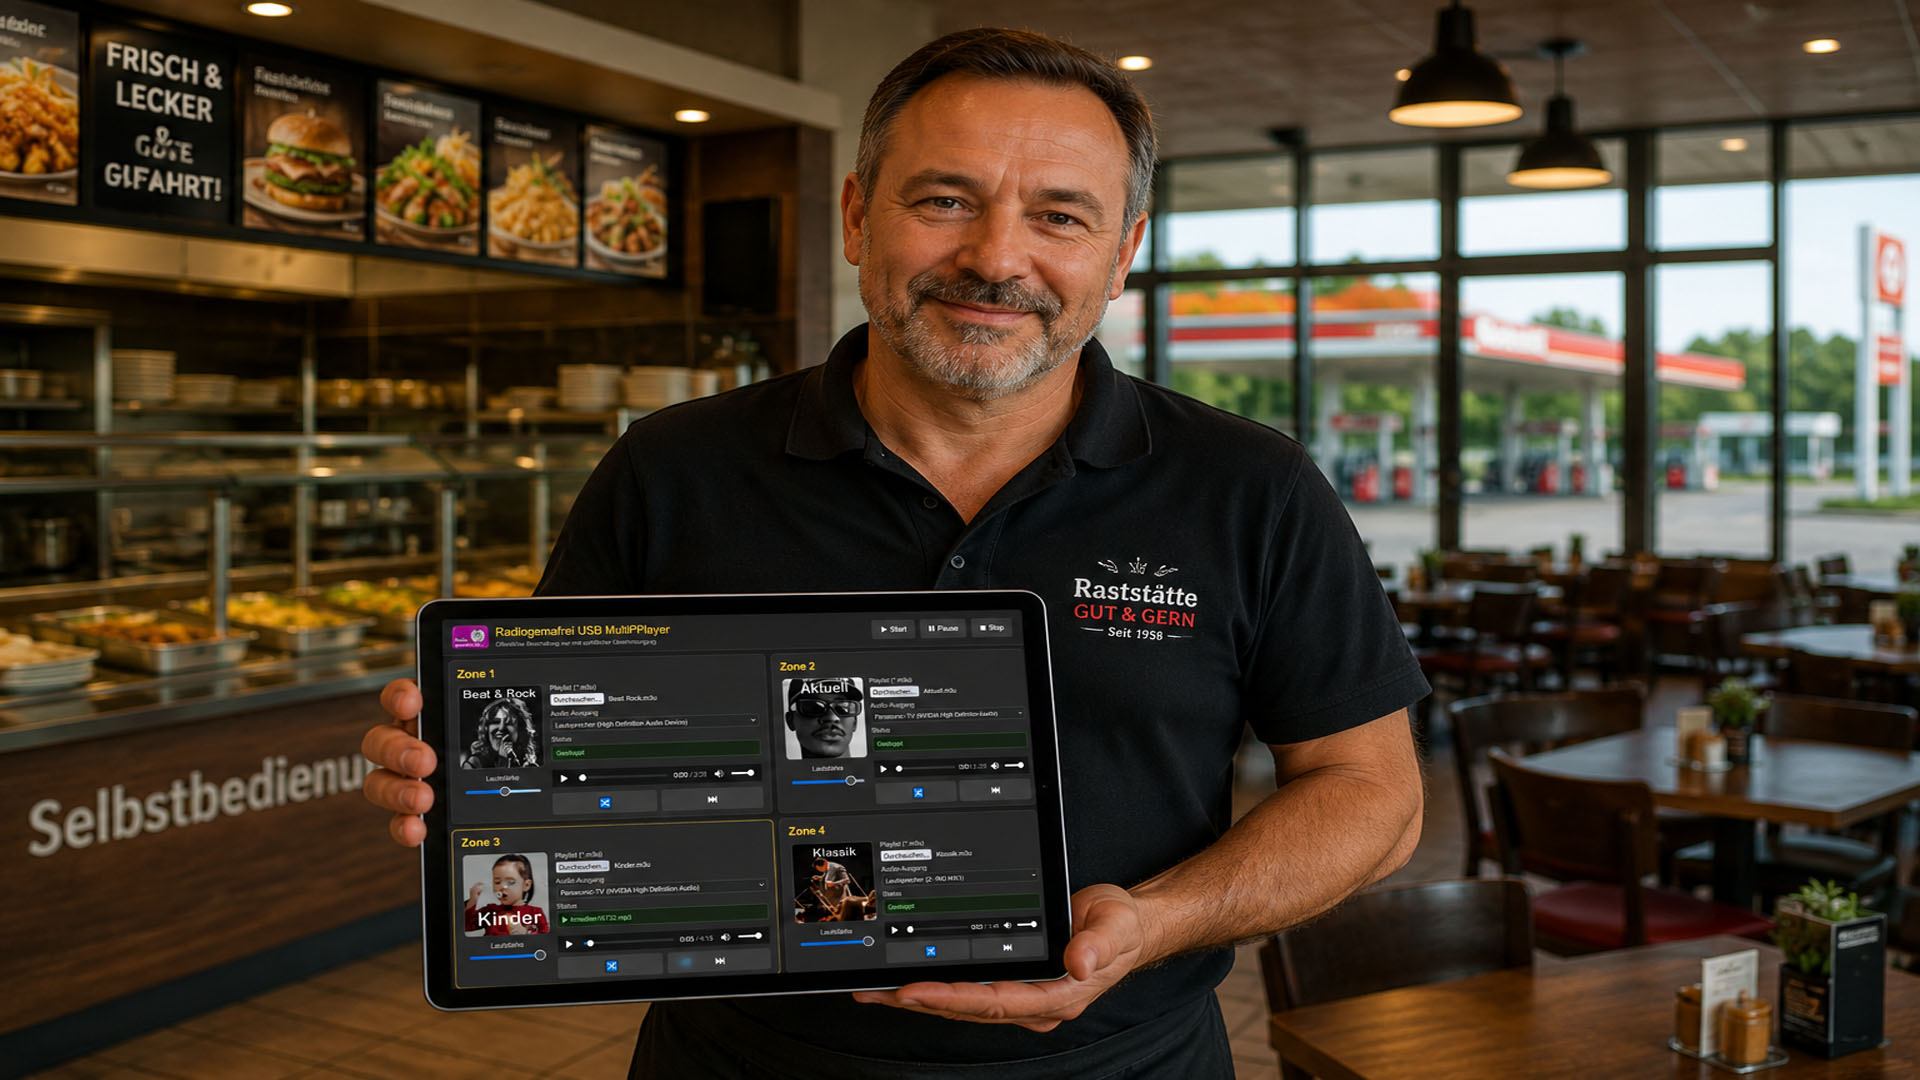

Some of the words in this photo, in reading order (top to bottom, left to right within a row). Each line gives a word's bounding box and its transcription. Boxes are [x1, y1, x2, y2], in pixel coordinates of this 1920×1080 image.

[106, 41, 199, 86] FRISCH
[203, 63, 224, 91] &
[115, 80, 214, 123] LECKER
[1073, 577, 1198, 608] Raststätte
[1073, 603, 1118, 621] GUT
[1121, 606, 1136, 622] &
[1141, 608, 1196, 628] GERN
[495, 625, 575, 639] Radiogemafrei
[577, 624, 602, 635] USB
[889, 625, 908, 633] Start
[937, 624, 959, 632] Pause
[988, 623, 1005, 632] Stop
[1107, 626, 1132, 638] Seit
[780, 661, 807, 671] Zone
[808, 661, 816, 671] 2
[456, 669, 487, 679] Zone
[490, 669, 495, 678] 1
[801, 681, 849, 694] Aktuell
[463, 690, 491, 699] Beat
[494, 689, 503, 699] &
[506, 688, 537, 698] Rock
[28, 754, 378, 857] Selbstbedienu
[788, 826, 816, 836] Zone
[818, 825, 825, 835] 4
[461, 837, 490, 847] Zone
[493, 837, 500, 846] 3
[812, 847, 857, 857] Klassik
[478, 910, 542, 927] Kinder
